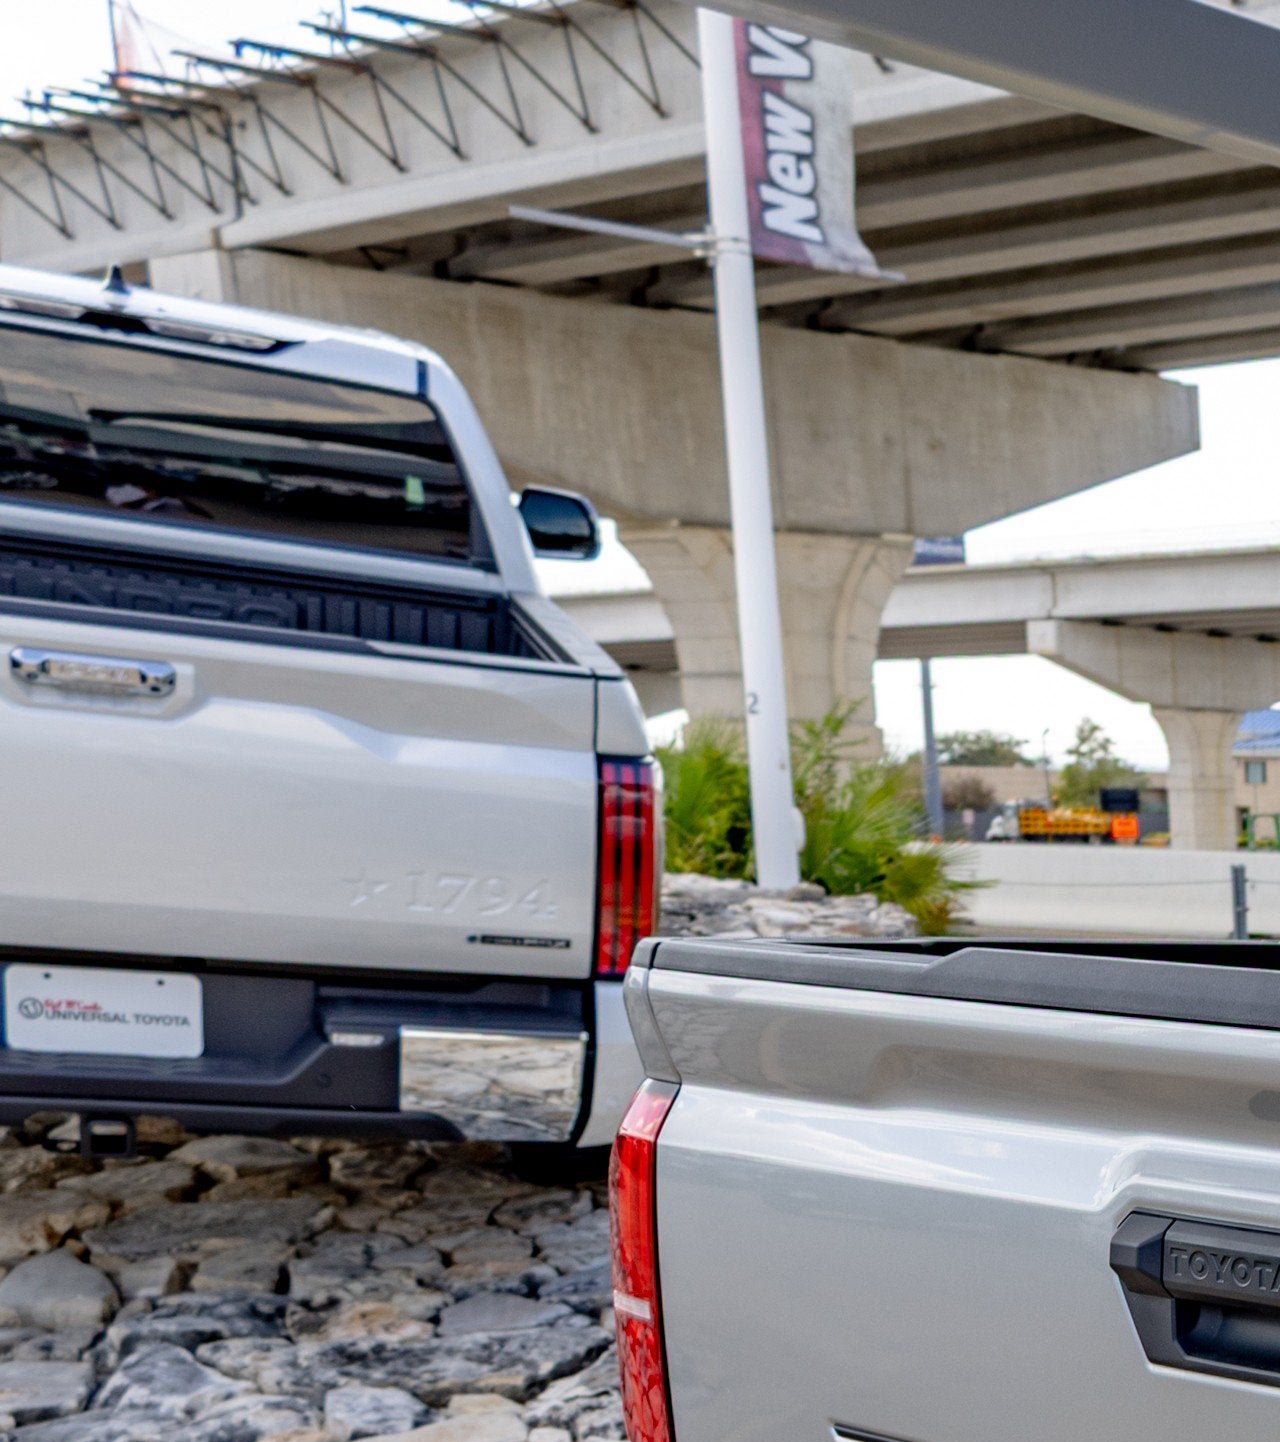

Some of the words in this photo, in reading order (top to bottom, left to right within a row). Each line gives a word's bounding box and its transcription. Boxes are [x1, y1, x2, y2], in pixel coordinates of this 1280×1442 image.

[757, 87, 827, 246] New
[404, 870, 559, 919] 1794
[45, 1010, 130, 1024] UNIVERSAL
[134, 1014, 190, 1027] TOYOTA
